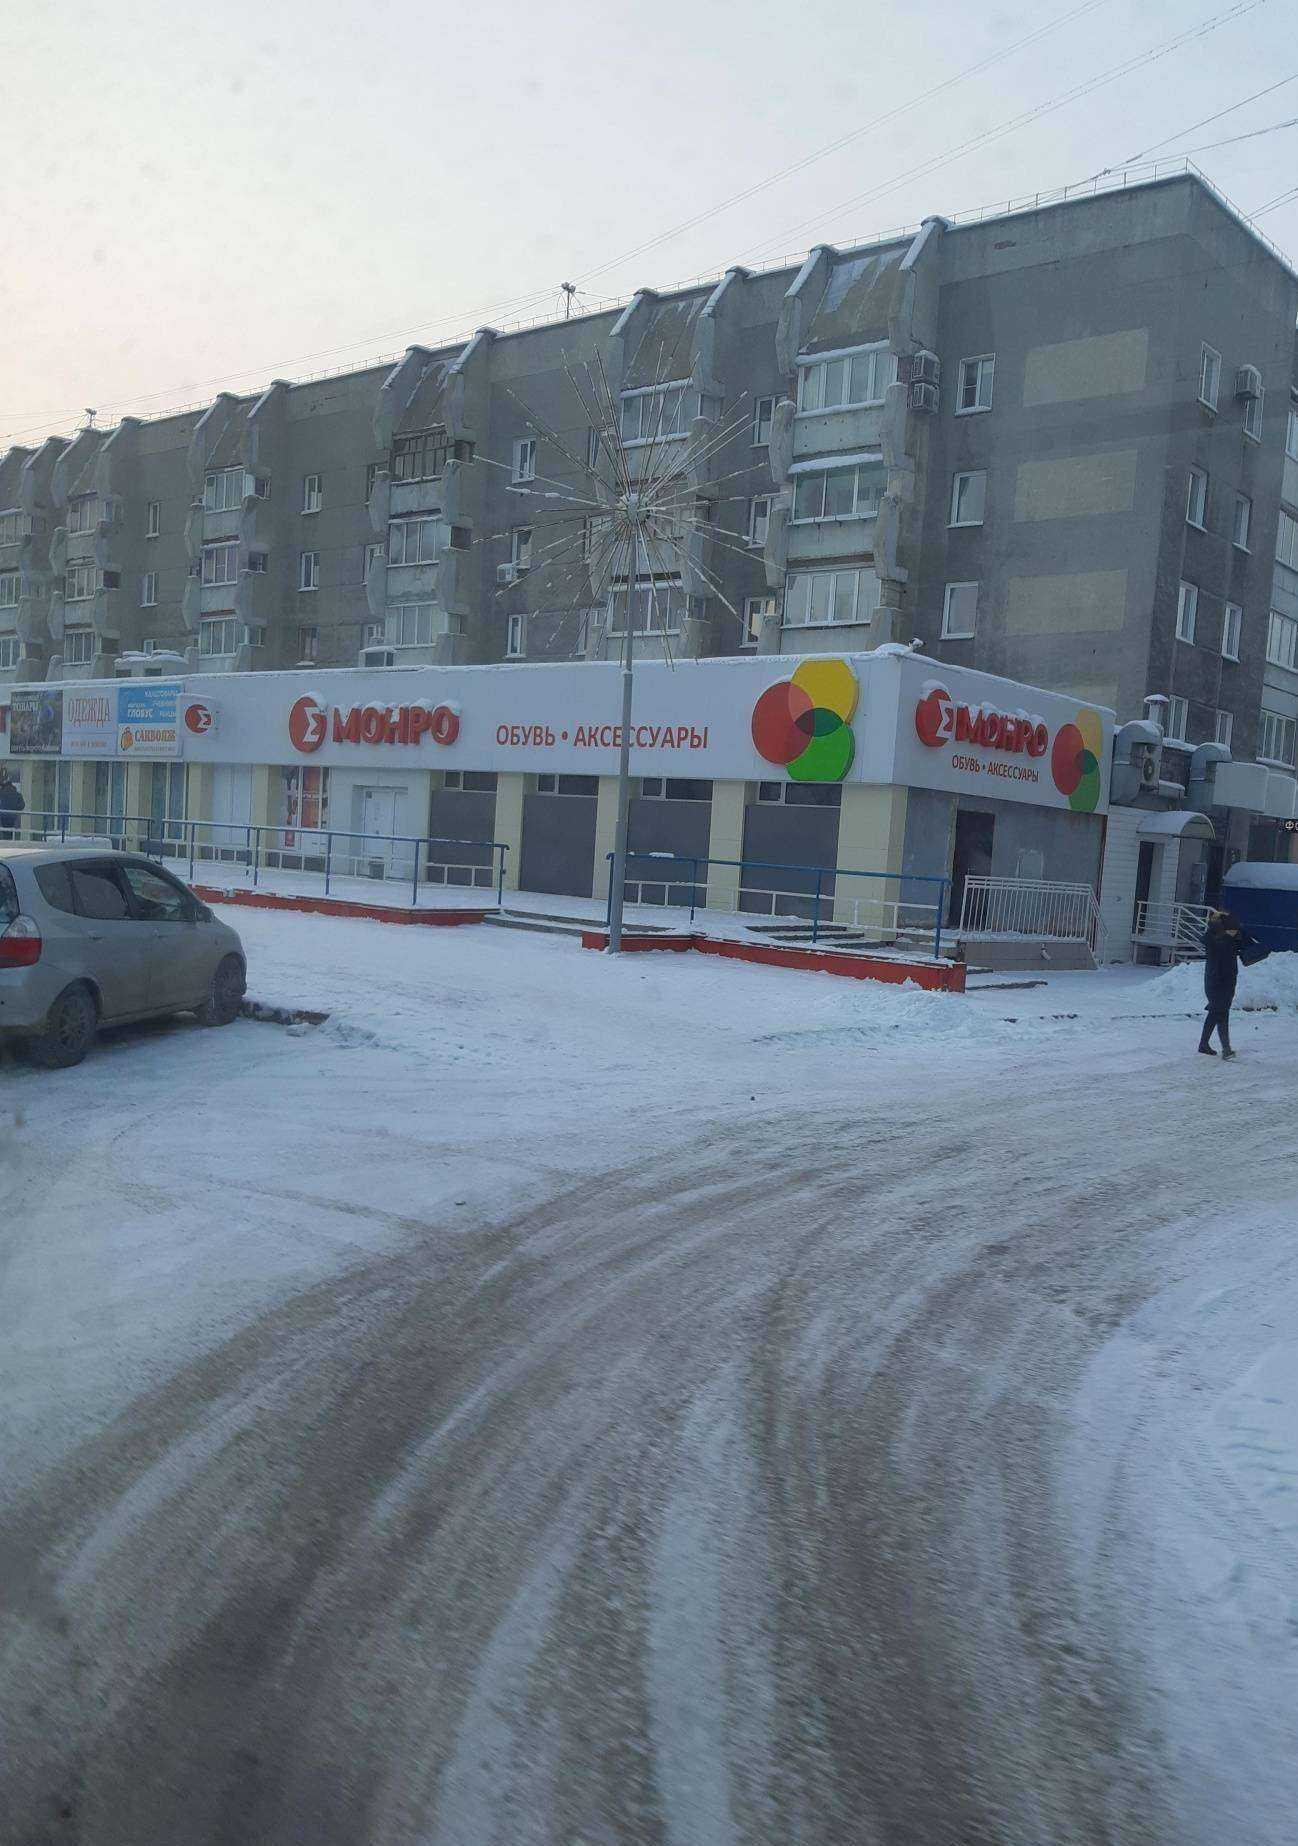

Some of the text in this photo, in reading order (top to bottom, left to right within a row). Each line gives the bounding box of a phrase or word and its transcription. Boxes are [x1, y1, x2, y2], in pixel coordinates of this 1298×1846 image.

[69, 697, 111, 728] ОДЕЖДА
[332, 703, 460, 746] МОНРО
[496, 724, 556, 747] ОБУВЬ
[955, 704, 1049, 758] МОНРО
[951, 754, 1040, 783] ОБУВЬ АКСЕССУАРЫ
